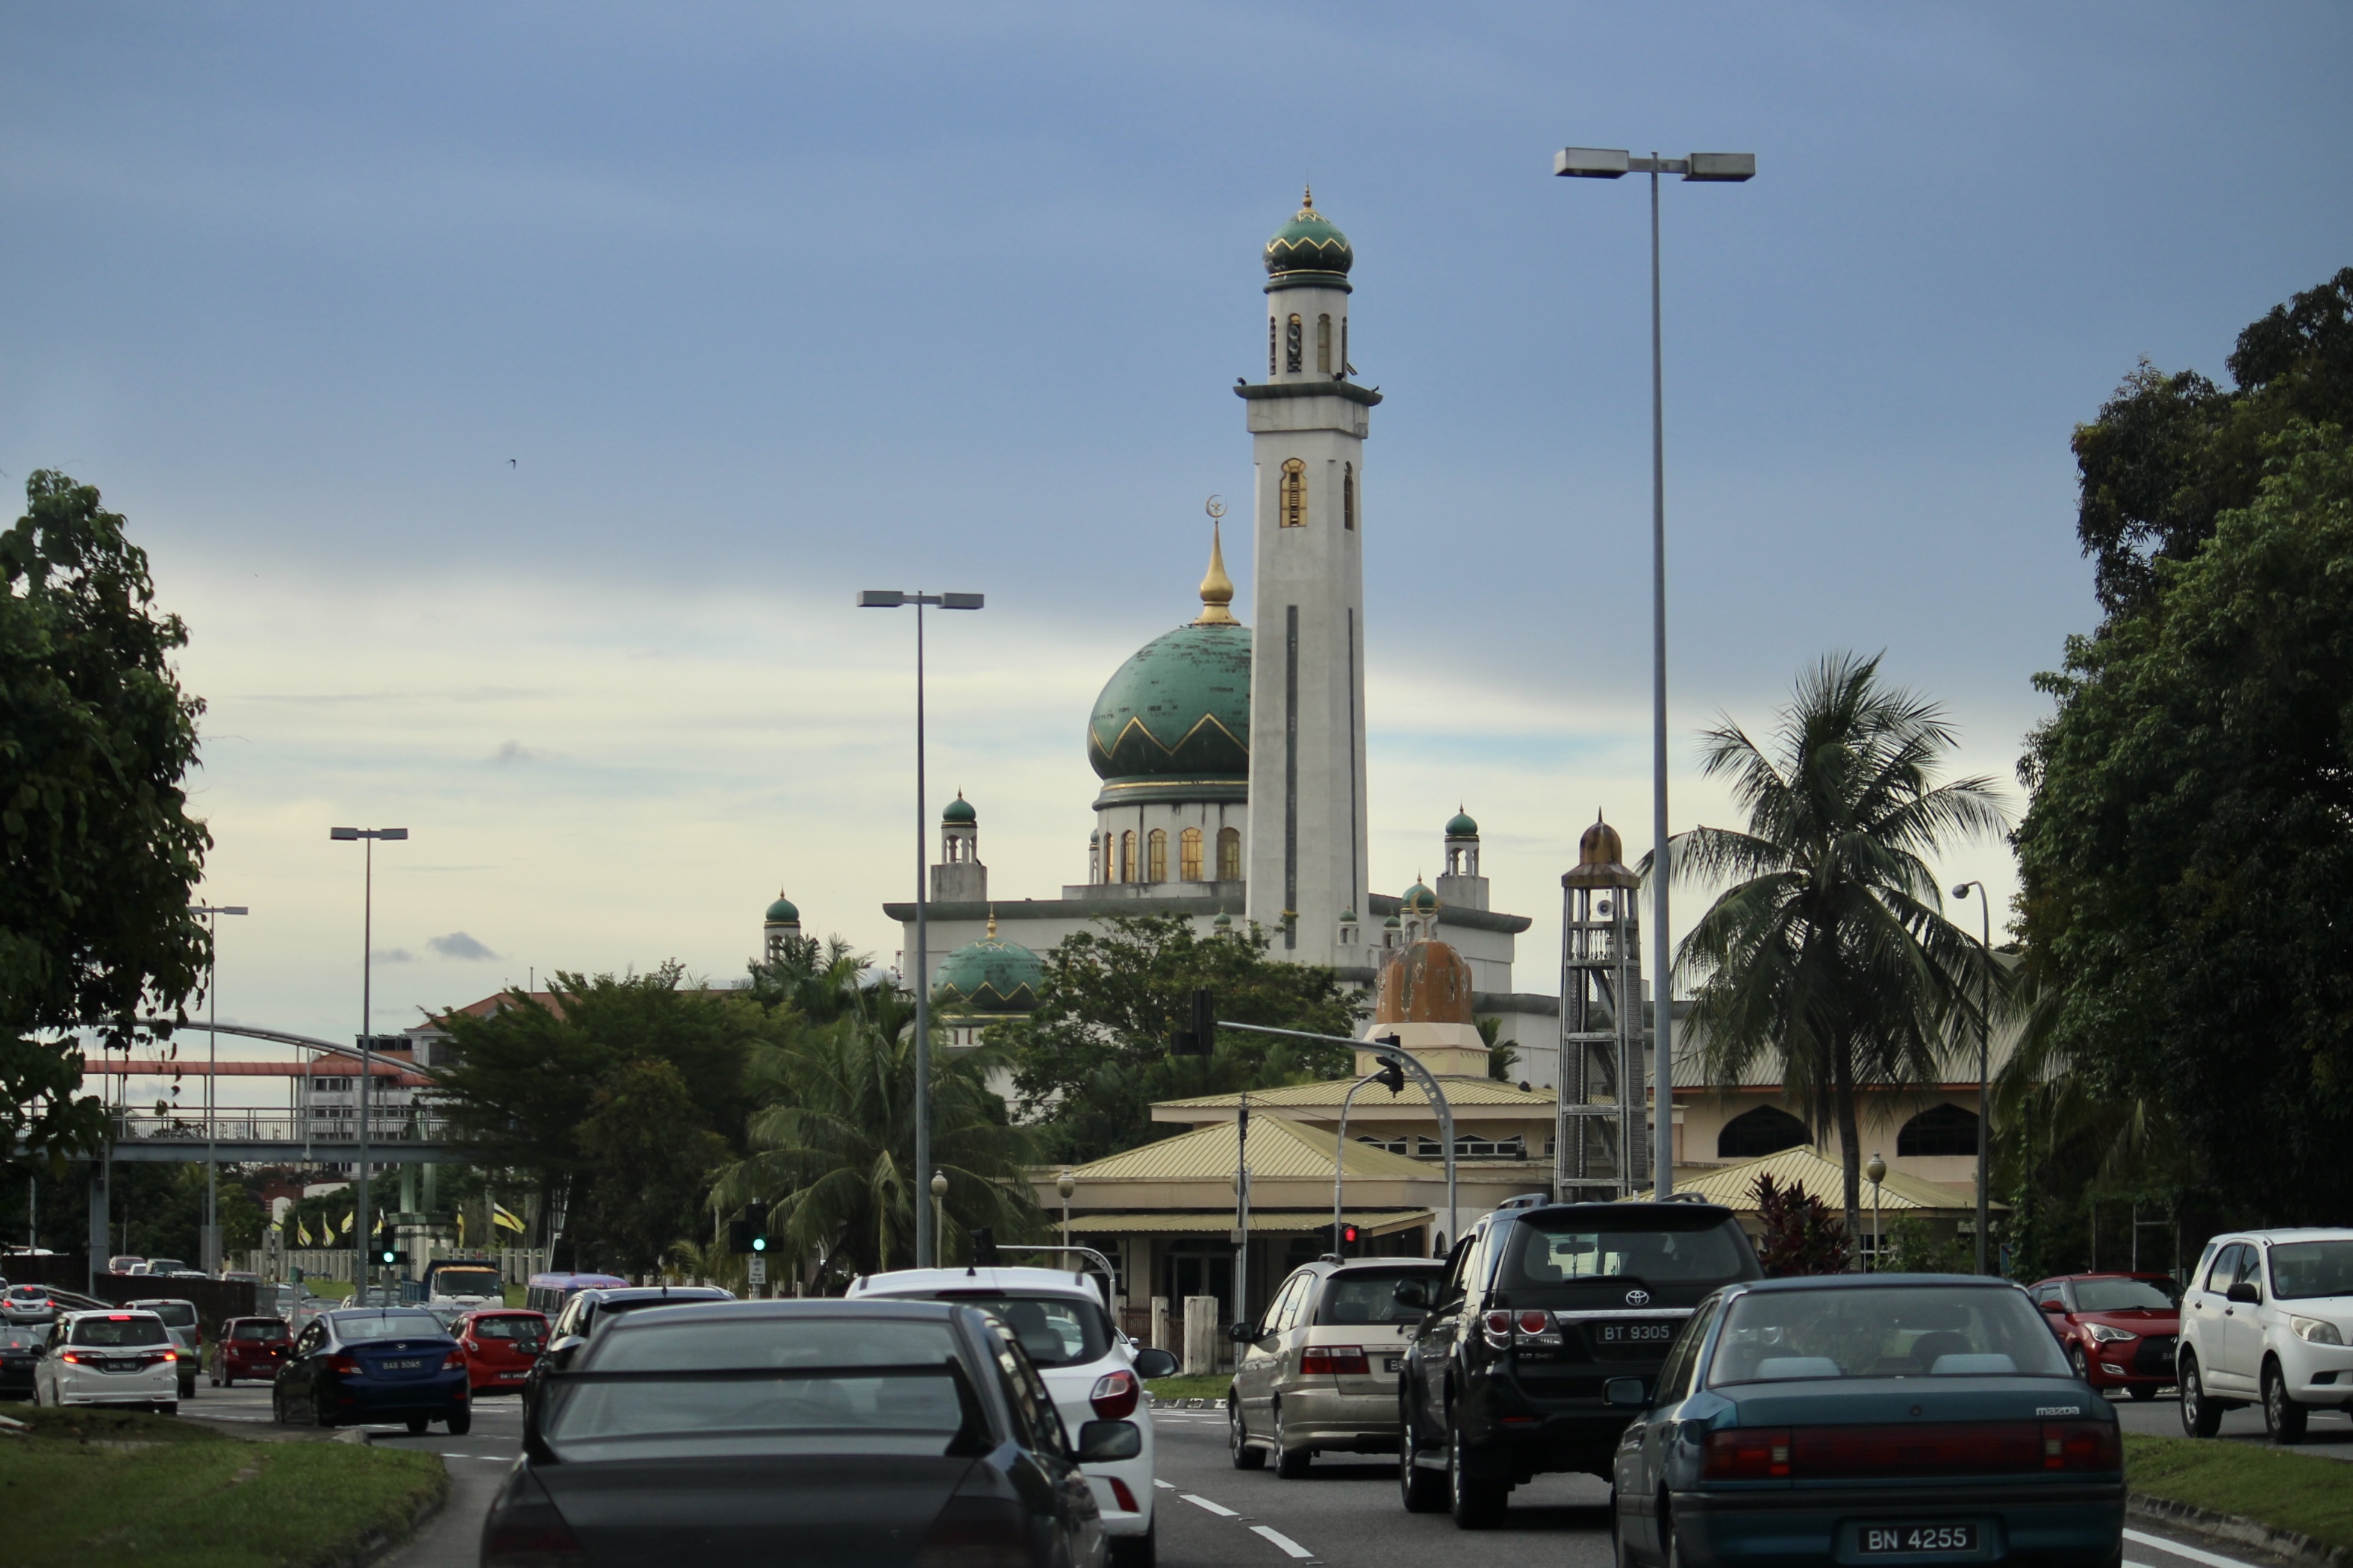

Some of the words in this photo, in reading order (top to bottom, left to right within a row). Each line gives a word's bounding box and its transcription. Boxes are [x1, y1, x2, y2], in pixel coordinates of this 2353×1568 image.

[1604, 1326, 1624, 1340] BT
[1630, 1325, 1670, 1339] 9305
[383, 1361, 399, 1369] BAS
[1390, 1360, 1399, 1370] B
[1869, 1530, 1898, 1550] BN
[1907, 1528, 1967, 1549] 4255
